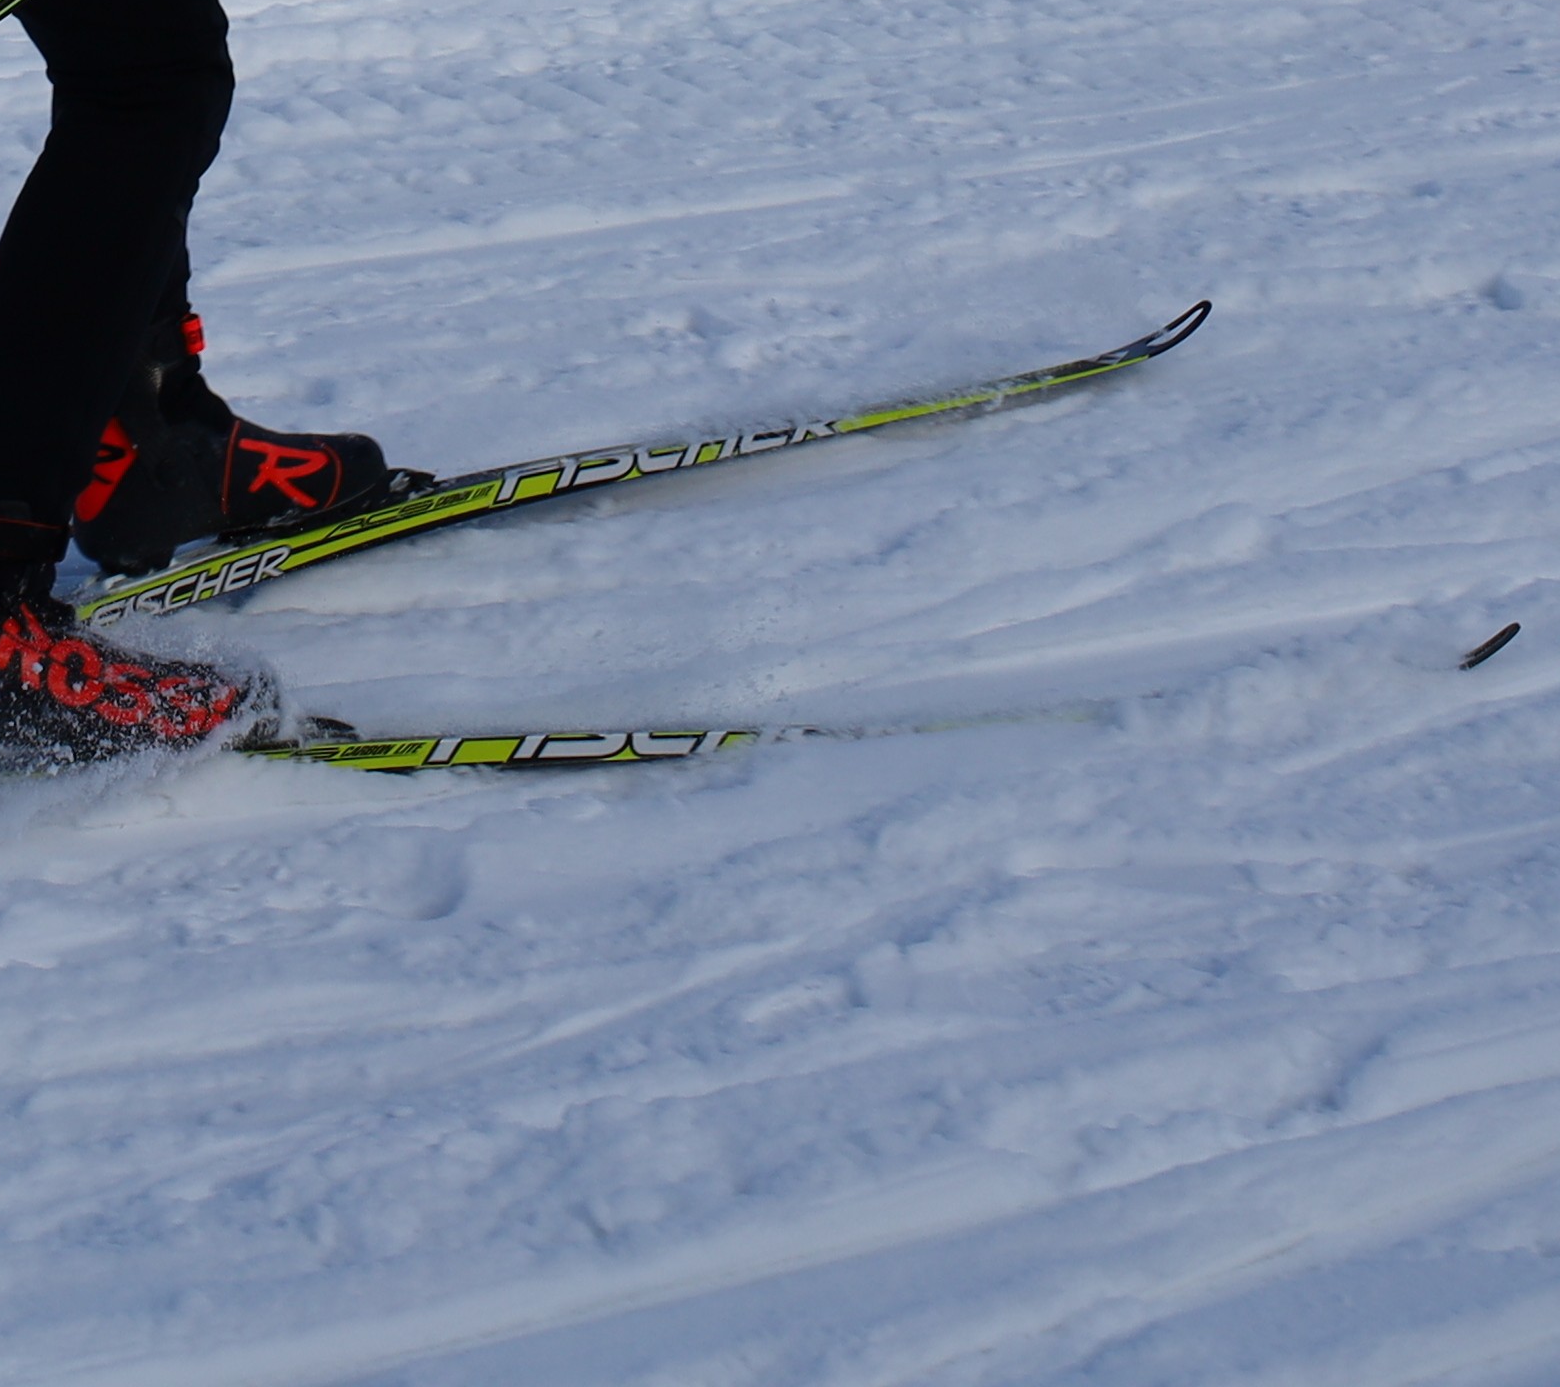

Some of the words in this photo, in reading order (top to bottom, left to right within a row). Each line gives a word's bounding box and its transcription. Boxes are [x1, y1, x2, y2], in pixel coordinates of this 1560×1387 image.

[90, 544, 291, 627] FISCHER
[339, 743, 396, 758] CARBON
[393, 742, 426, 755] LITE
